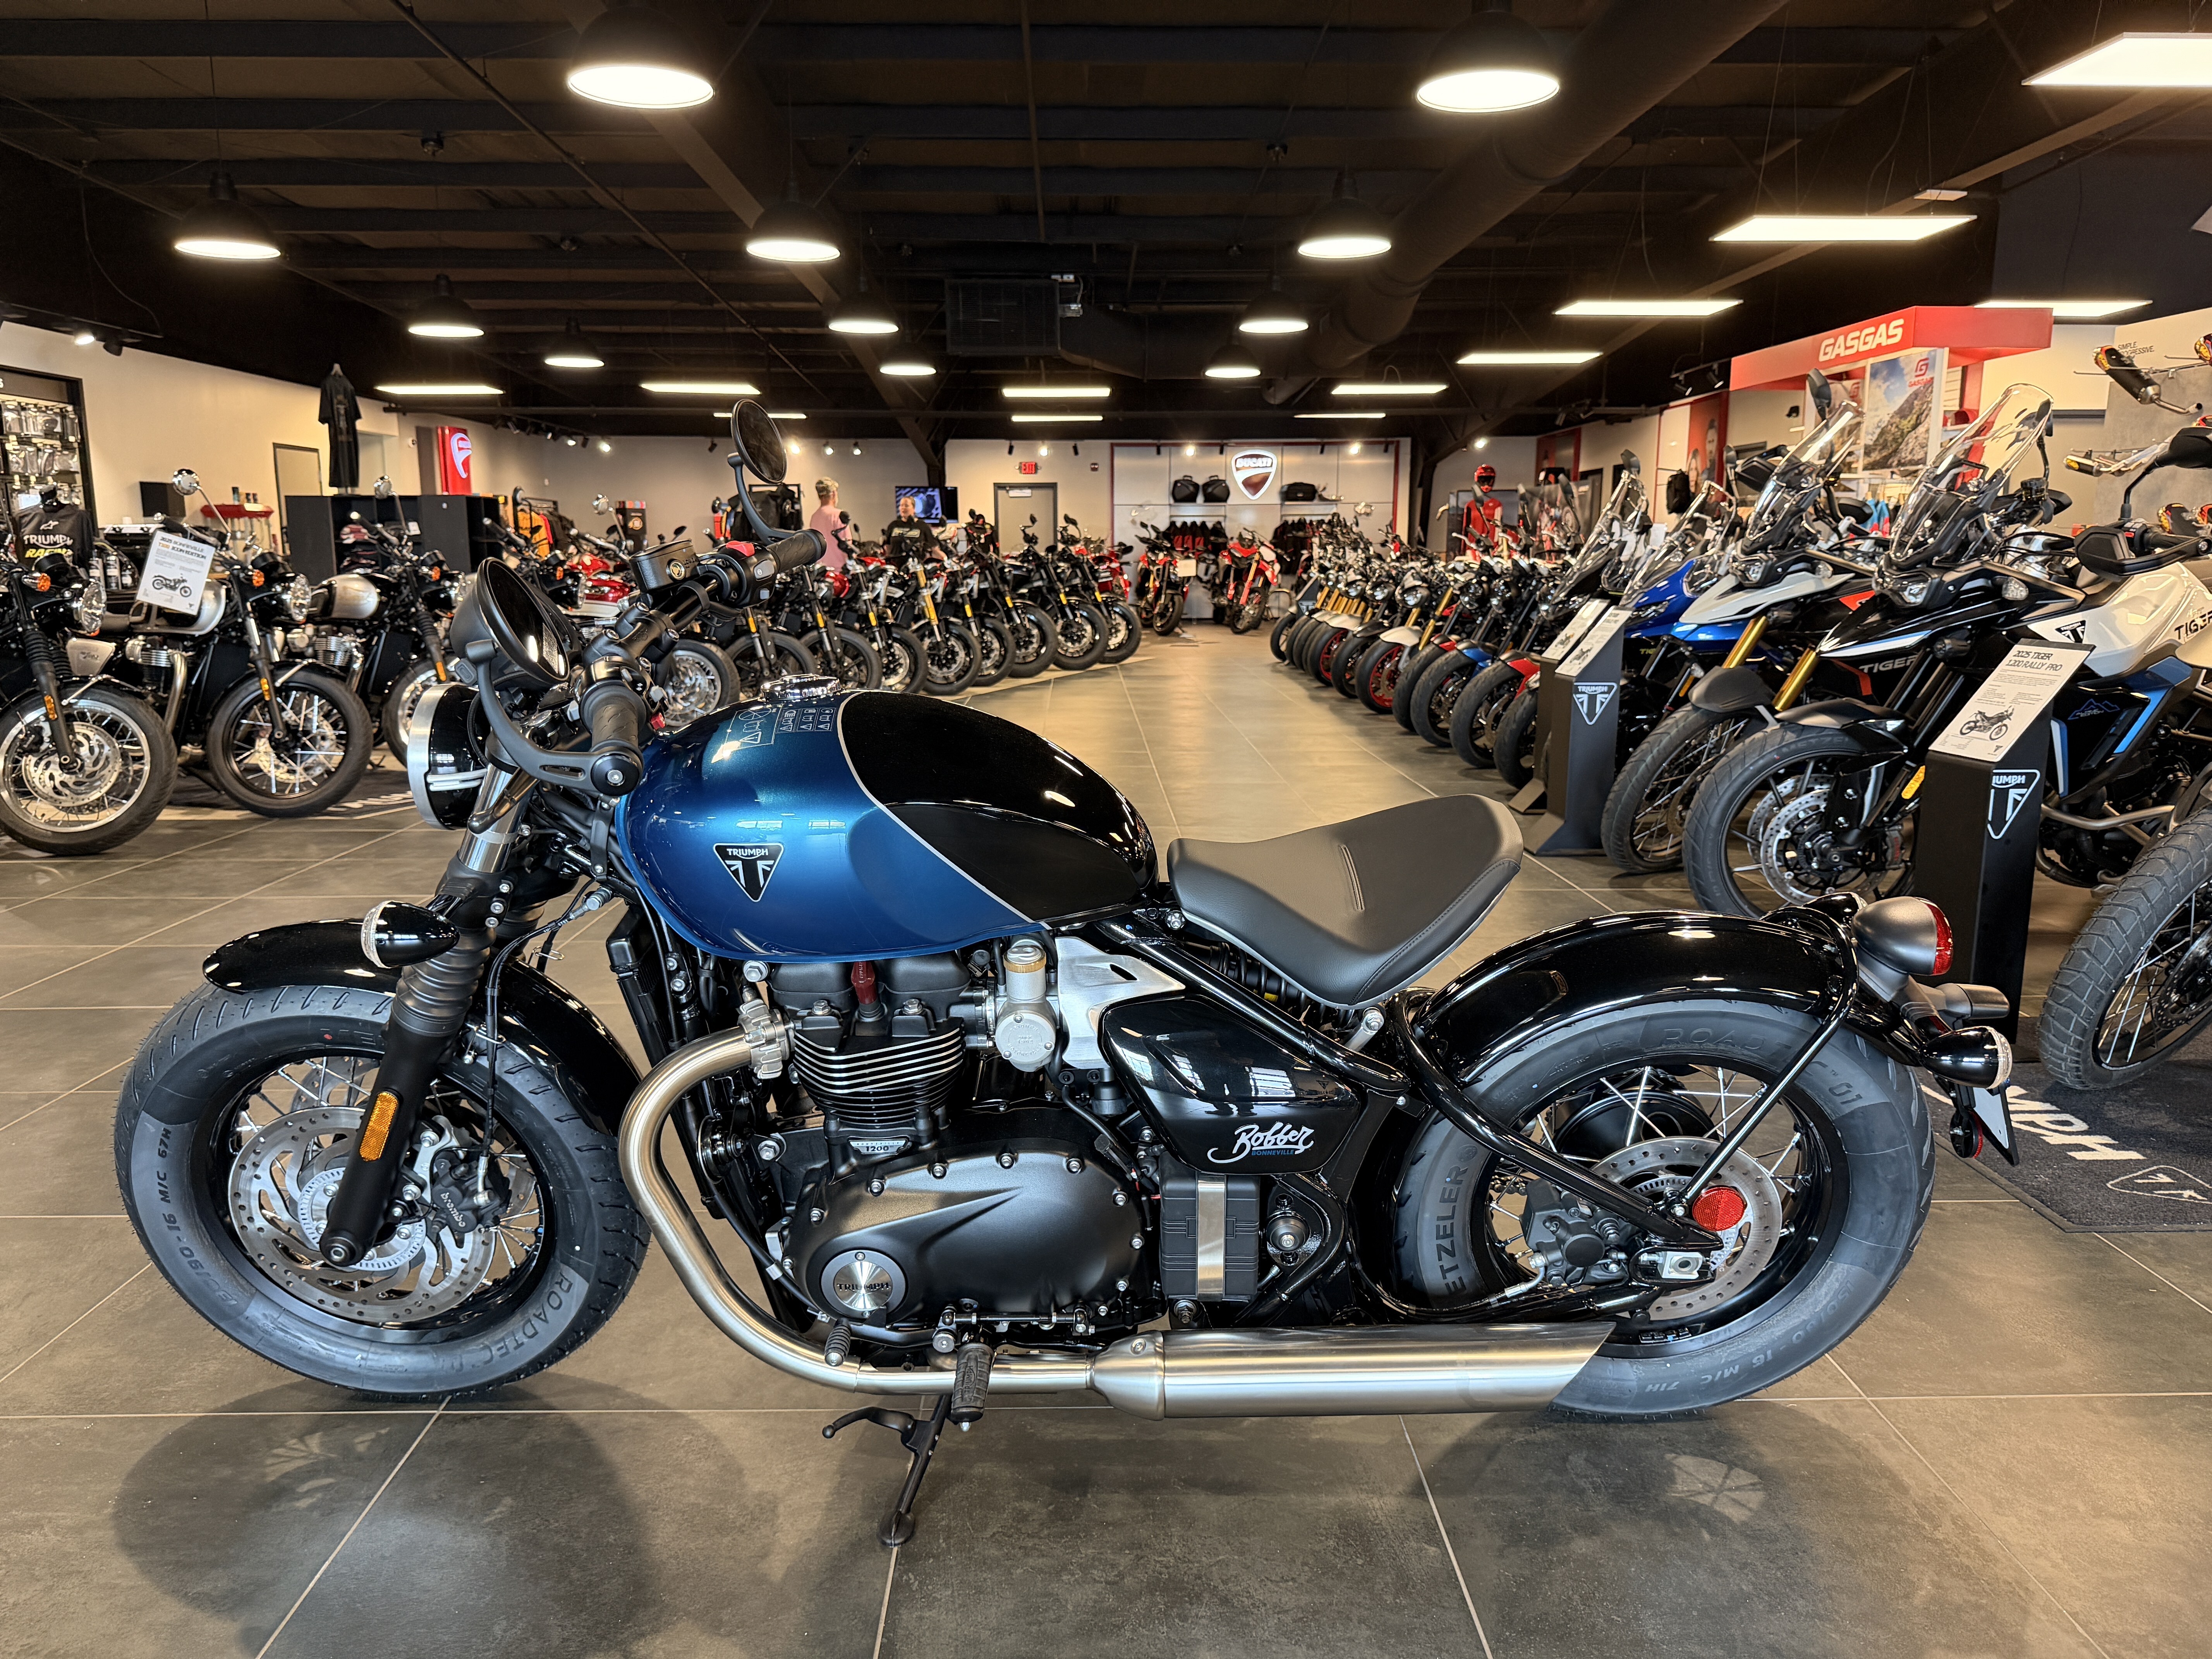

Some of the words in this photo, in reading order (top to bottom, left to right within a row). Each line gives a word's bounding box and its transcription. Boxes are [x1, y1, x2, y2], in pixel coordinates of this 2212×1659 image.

[1819, 318, 1904, 362] GASGAS
[1022, 462, 1035, 473] EXIT
[1236, 458, 1272, 468] DUCATI
[2022, 661, 2047, 669] RALLY
[2030, 652, 2053, 660] TIGER
[1578, 686, 1608, 694] TRIUMPH
[726, 848, 768, 859] TRIUMPH
[1828, 1082, 1863, 1105] 01
[158, 1128, 172, 1158] 67H
[1207, 1121, 1314, 1163] Bobber
[157, 1171, 171, 1203] M/C
[440, 1192, 465, 1227] brembo
[1436, 1166, 1468, 1294] ETZELER
[479, 1272, 574, 1365] ROADTEC
[1700, 1365, 1739, 1384] M/C
[1645, 1381, 1680, 1392] 71H
